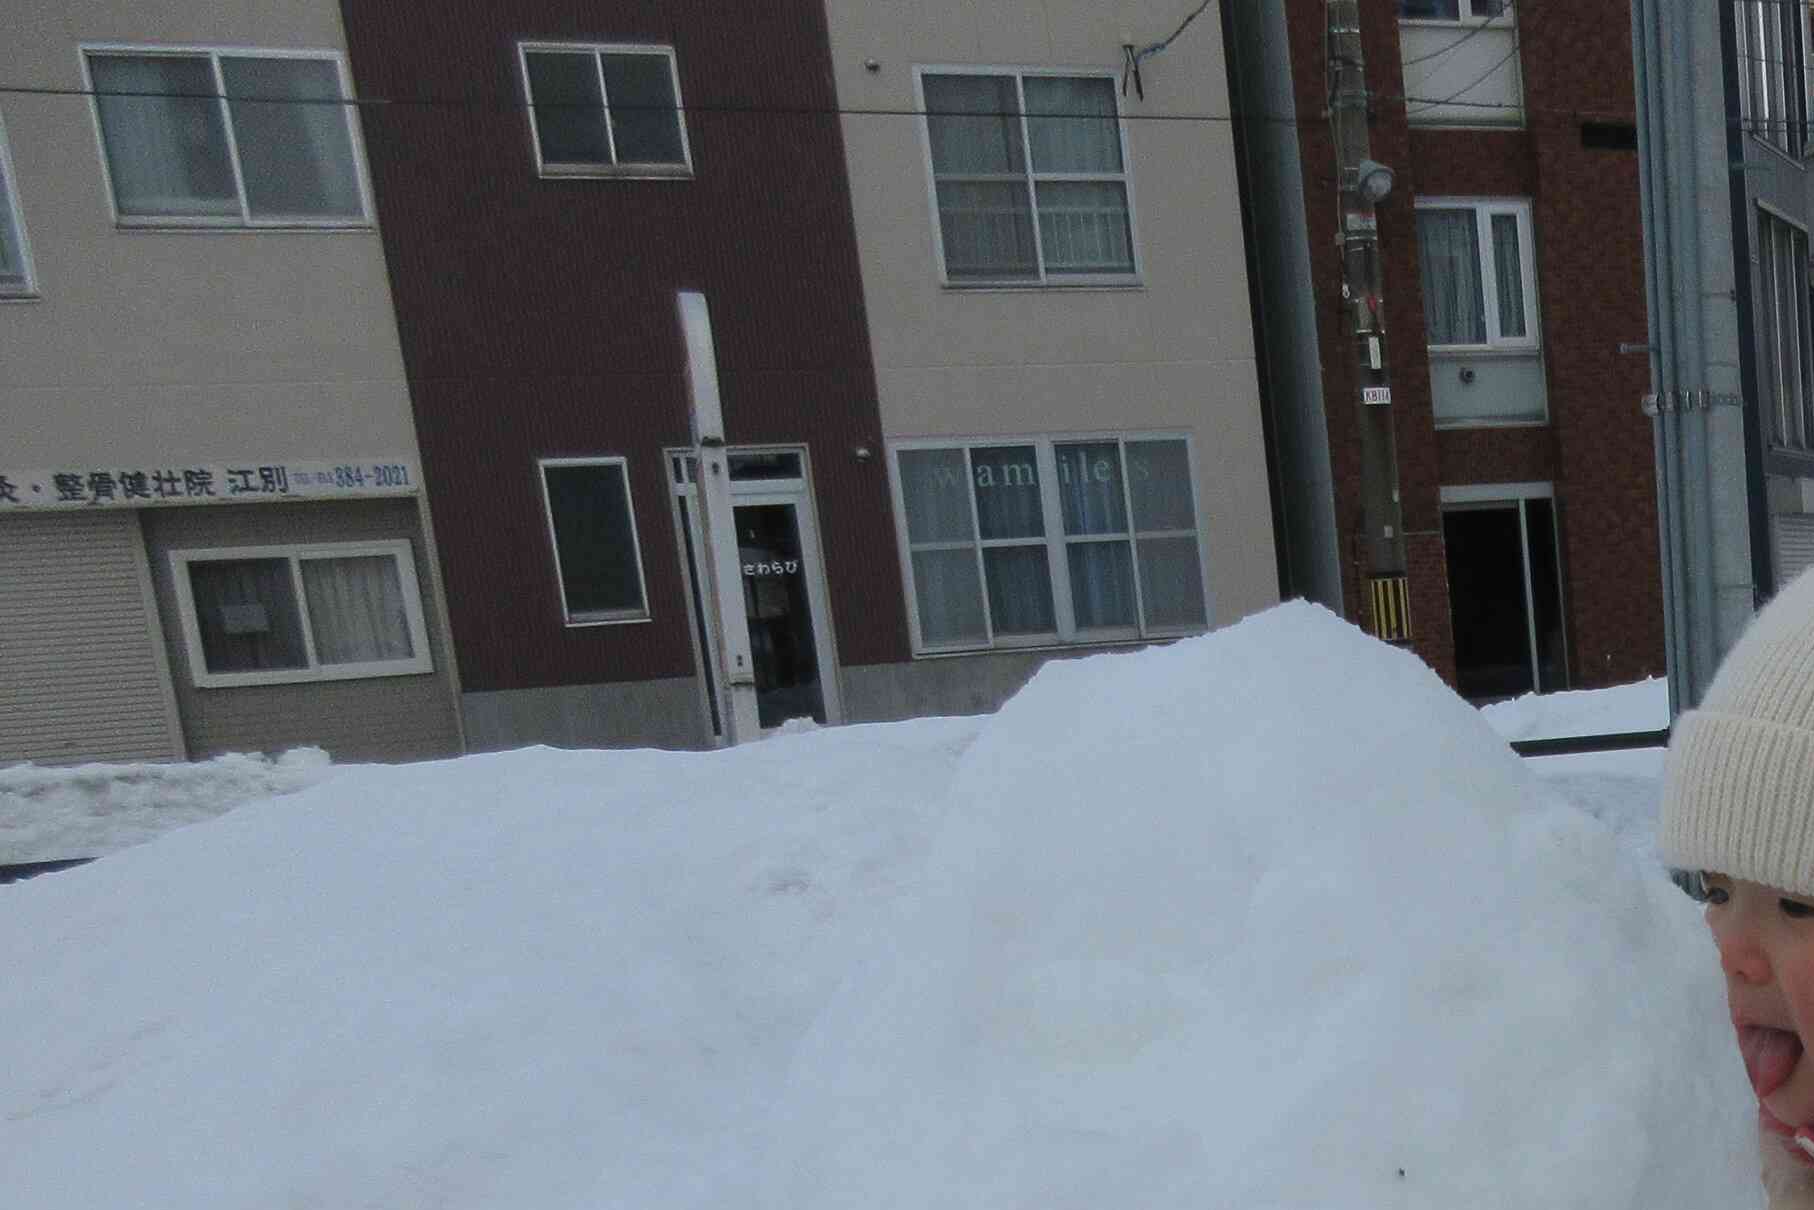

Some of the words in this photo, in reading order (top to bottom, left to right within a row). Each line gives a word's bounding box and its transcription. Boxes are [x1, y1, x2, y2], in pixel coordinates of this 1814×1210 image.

[227, 465, 290, 496] 江別
[743, 561, 798, 576] さわらび
